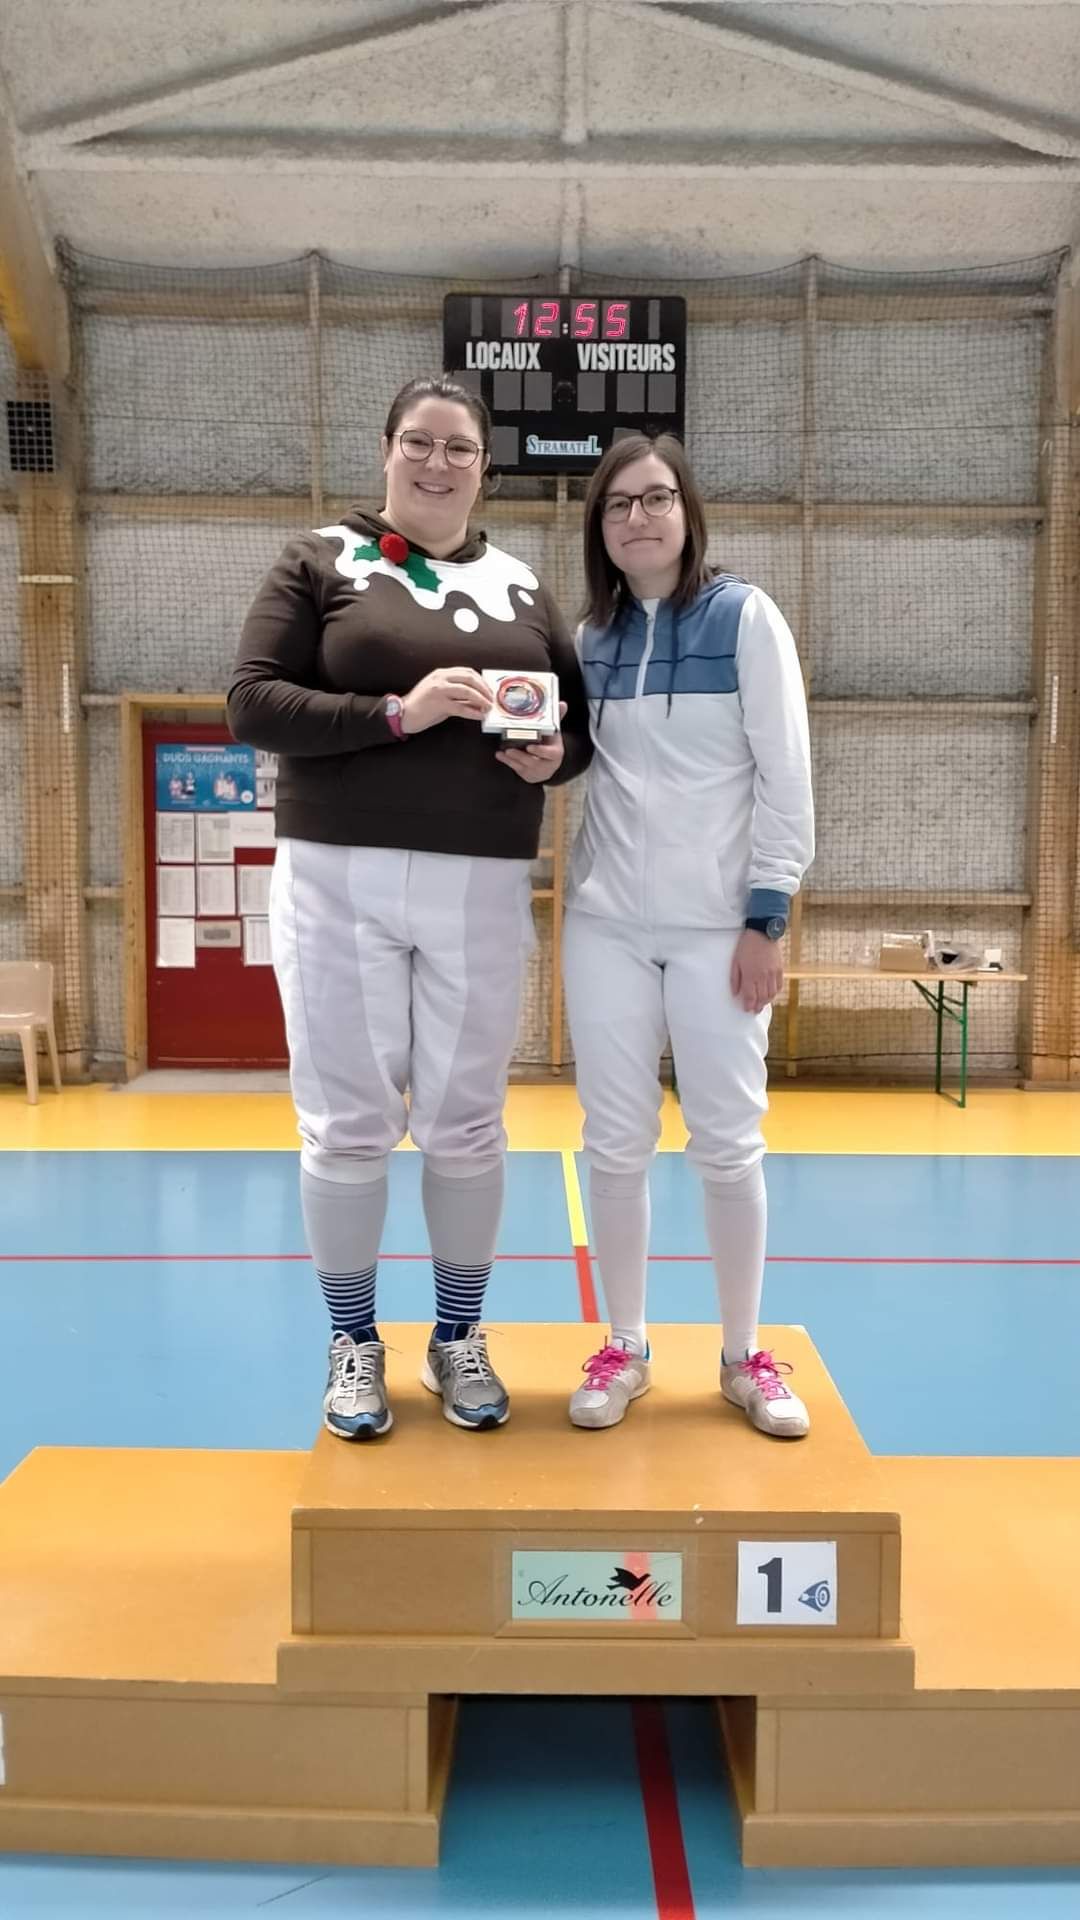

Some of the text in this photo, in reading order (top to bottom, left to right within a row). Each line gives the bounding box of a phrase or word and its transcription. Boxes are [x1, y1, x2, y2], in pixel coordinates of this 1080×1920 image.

[514, 302, 628, 337] 12:55
[466, 342, 675, 372] LOCAUX VISITEURS
[517, 1573, 672, 1608] Antonelle
[757, 1557, 782, 1613] 1
